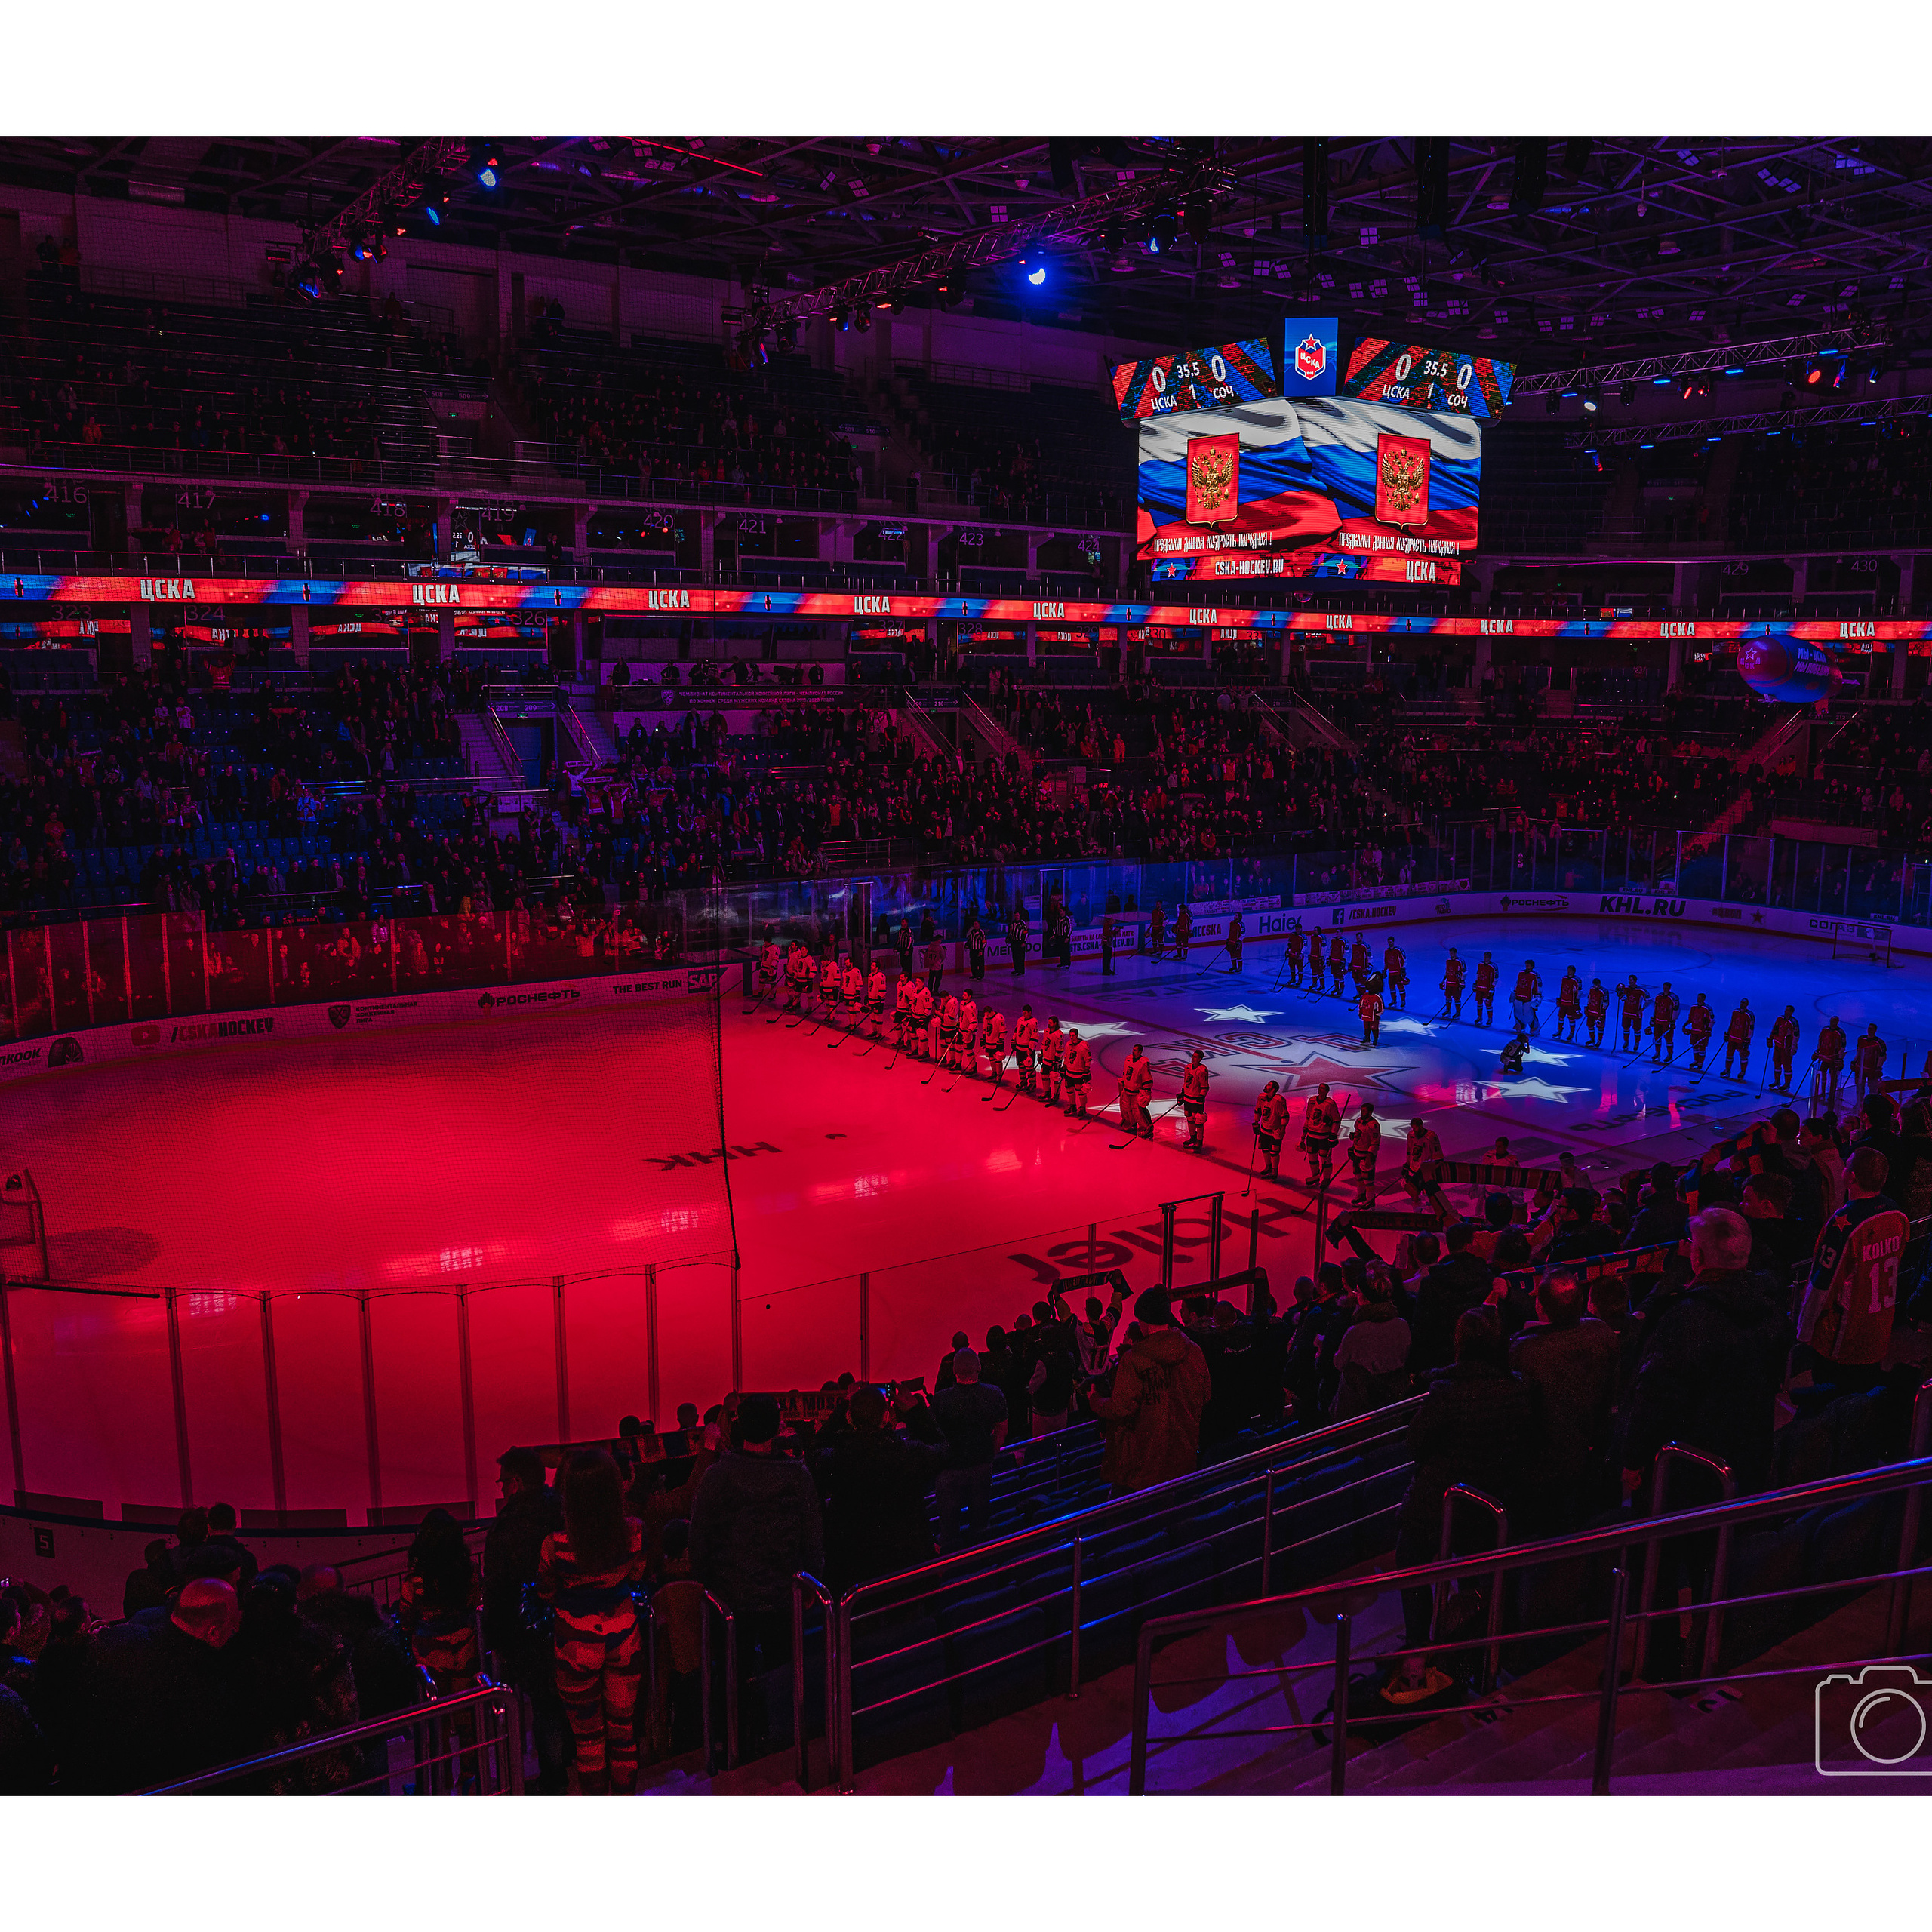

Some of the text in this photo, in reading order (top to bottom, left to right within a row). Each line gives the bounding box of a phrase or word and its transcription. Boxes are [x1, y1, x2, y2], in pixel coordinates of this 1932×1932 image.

[1300, 352, 1320, 368] ЦСКА
[1152, 355, 1226, 392] 0 35.5 0
[1395, 354, 1472, 392] 0 35.5 0
[1151, 395, 1177, 411] ЦСКА
[1189, 384, 1196, 401] 1
[1382, 383, 1410, 400] ЦСКА
[1426, 383, 1434, 400] 1
[45, 486, 88, 503] 416
[177, 491, 217, 509] 417
[370, 500, 406, 518] 418
[481, 506, 515, 521] 419
[643, 514, 674, 529] 420
[739, 519, 766, 534] 421
[959, 532, 983, 546] 423
[1215, 558, 1284, 575] CSKA-HOCKEY.RU
[1406, 561, 1435, 583] ЦСКА
[1722, 563, 1749, 576] 429
[1850, 559, 1878, 572] 430
[140, 579, 195, 601] ЦСКА
[413, 584, 460, 605] ЦСКА
[648, 590, 690, 610] ЦСКА
[854, 596, 891, 614] ЦСКА
[51, 604, 92, 621] 323
[188, 605, 226, 621] 324
[512, 611, 545, 626] 326
[1033, 602, 1065, 620] ЦСКА
[1189, 608, 1217, 625] ЦСКА
[958, 623, 982, 635] 328
[1326, 614, 1352, 630] ЦСКА
[1481, 620, 1513, 634] ЦСКА
[1660, 622, 1695, 638] ЦСКА
[1840, 622, 1875, 638] ЦСКА
[1349, 906, 1396, 920] /CSKA.HOCKEY
[1600, 896, 1686, 917] KHL.RU
[1259, 913, 1301, 934] Haier
[987, 943, 1041, 957] МЕГФО
[613, 971, 718, 994] THE BEST RUN SAP
[497, 989, 580, 1007] РОСНЕФТЬ
[1008, 1197, 1337, 1284] Haier
[1863, 1235, 1902, 1262] KOLKO
[1819, 1244, 1837, 1269] 13
[1868, 1256, 1899, 1314] 13
